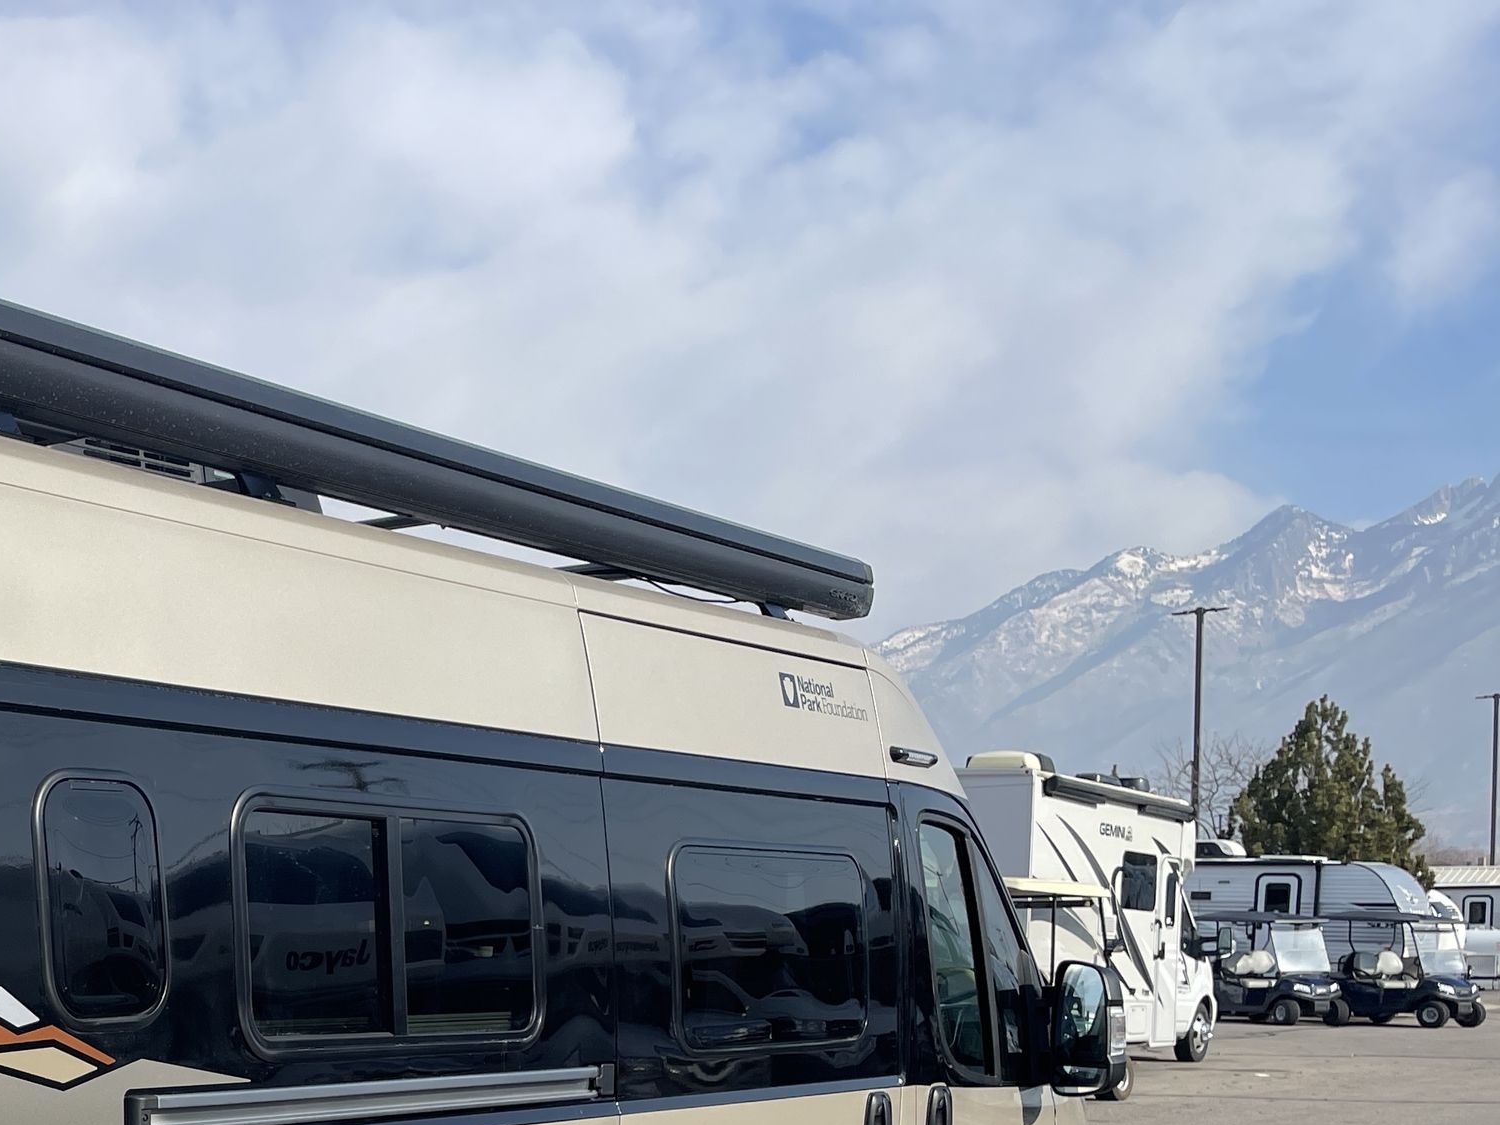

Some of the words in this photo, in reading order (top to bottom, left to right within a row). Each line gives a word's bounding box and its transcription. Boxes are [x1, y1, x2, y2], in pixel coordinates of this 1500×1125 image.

[796, 675, 834, 698] National
[800, 694, 823, 713] Park
[822, 698, 868, 721] Foundation
